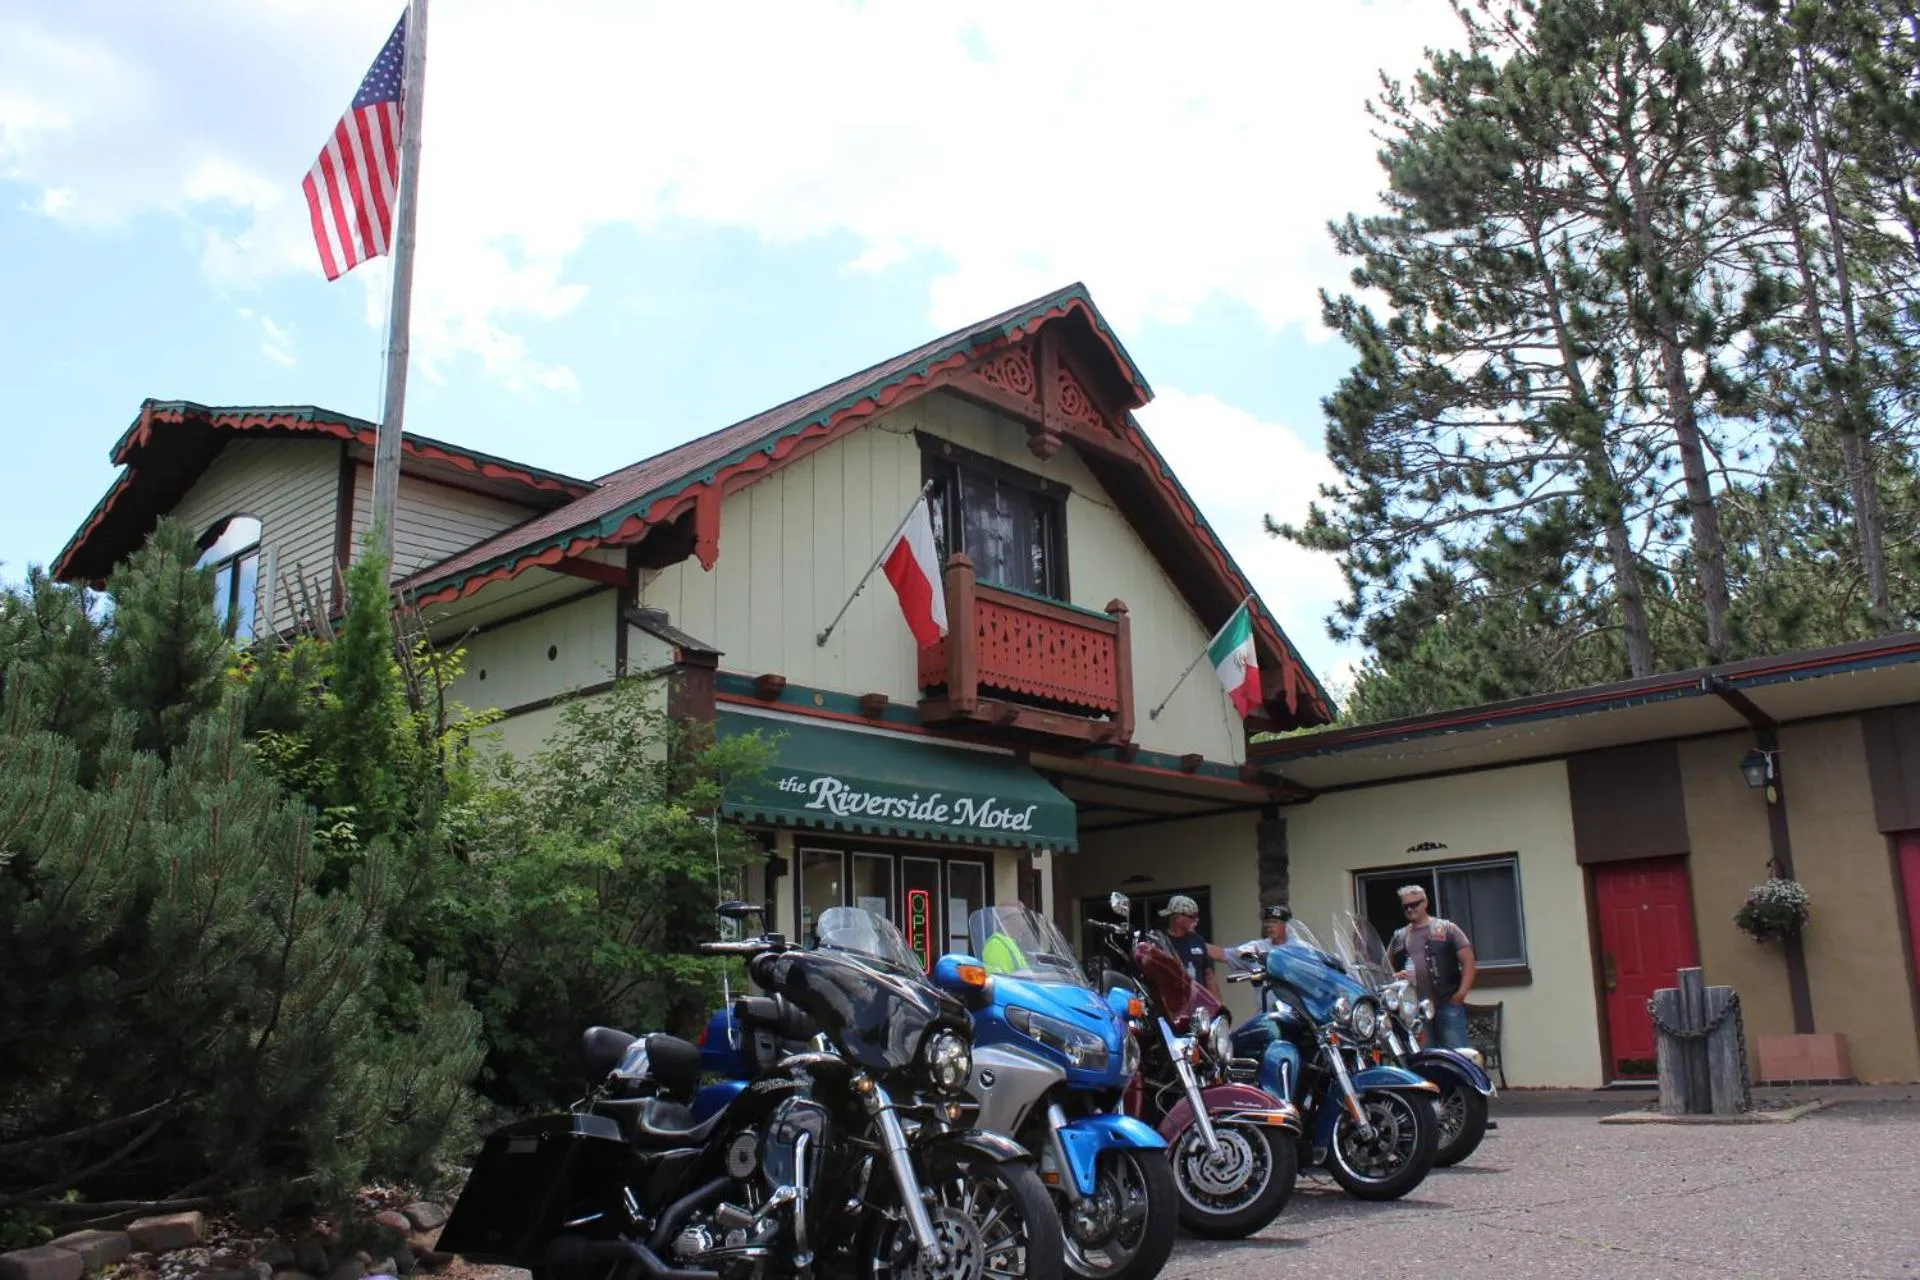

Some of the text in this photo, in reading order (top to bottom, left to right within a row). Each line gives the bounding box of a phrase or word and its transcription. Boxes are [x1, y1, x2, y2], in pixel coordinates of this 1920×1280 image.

[778, 775, 1037, 831] the Riverside Motel
